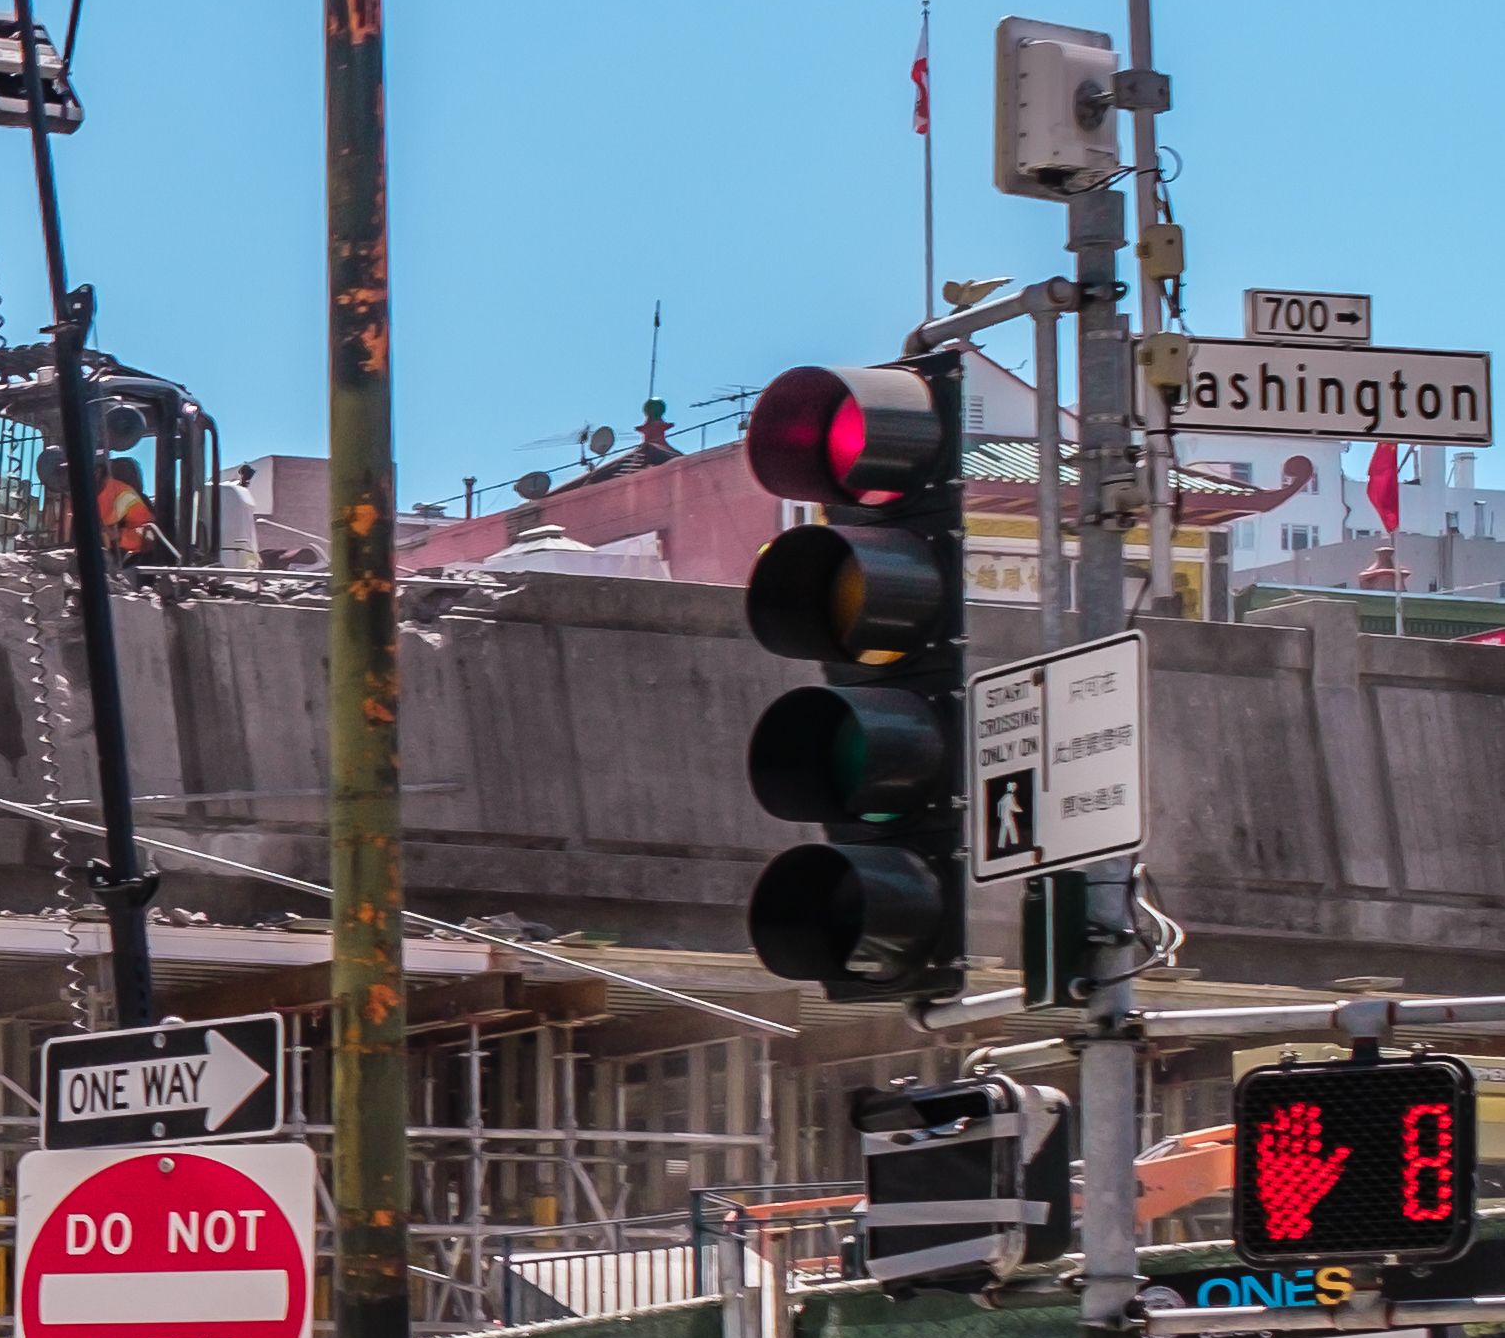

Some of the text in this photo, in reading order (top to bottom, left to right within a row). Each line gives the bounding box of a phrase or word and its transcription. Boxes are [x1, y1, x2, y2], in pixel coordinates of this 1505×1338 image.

[1262, 297, 1328, 333] 700
[1195, 363, 1478, 432] ashington
[70, 1061, 207, 1115] ONE WAY
[66, 1209, 266, 1256] DO NOT
